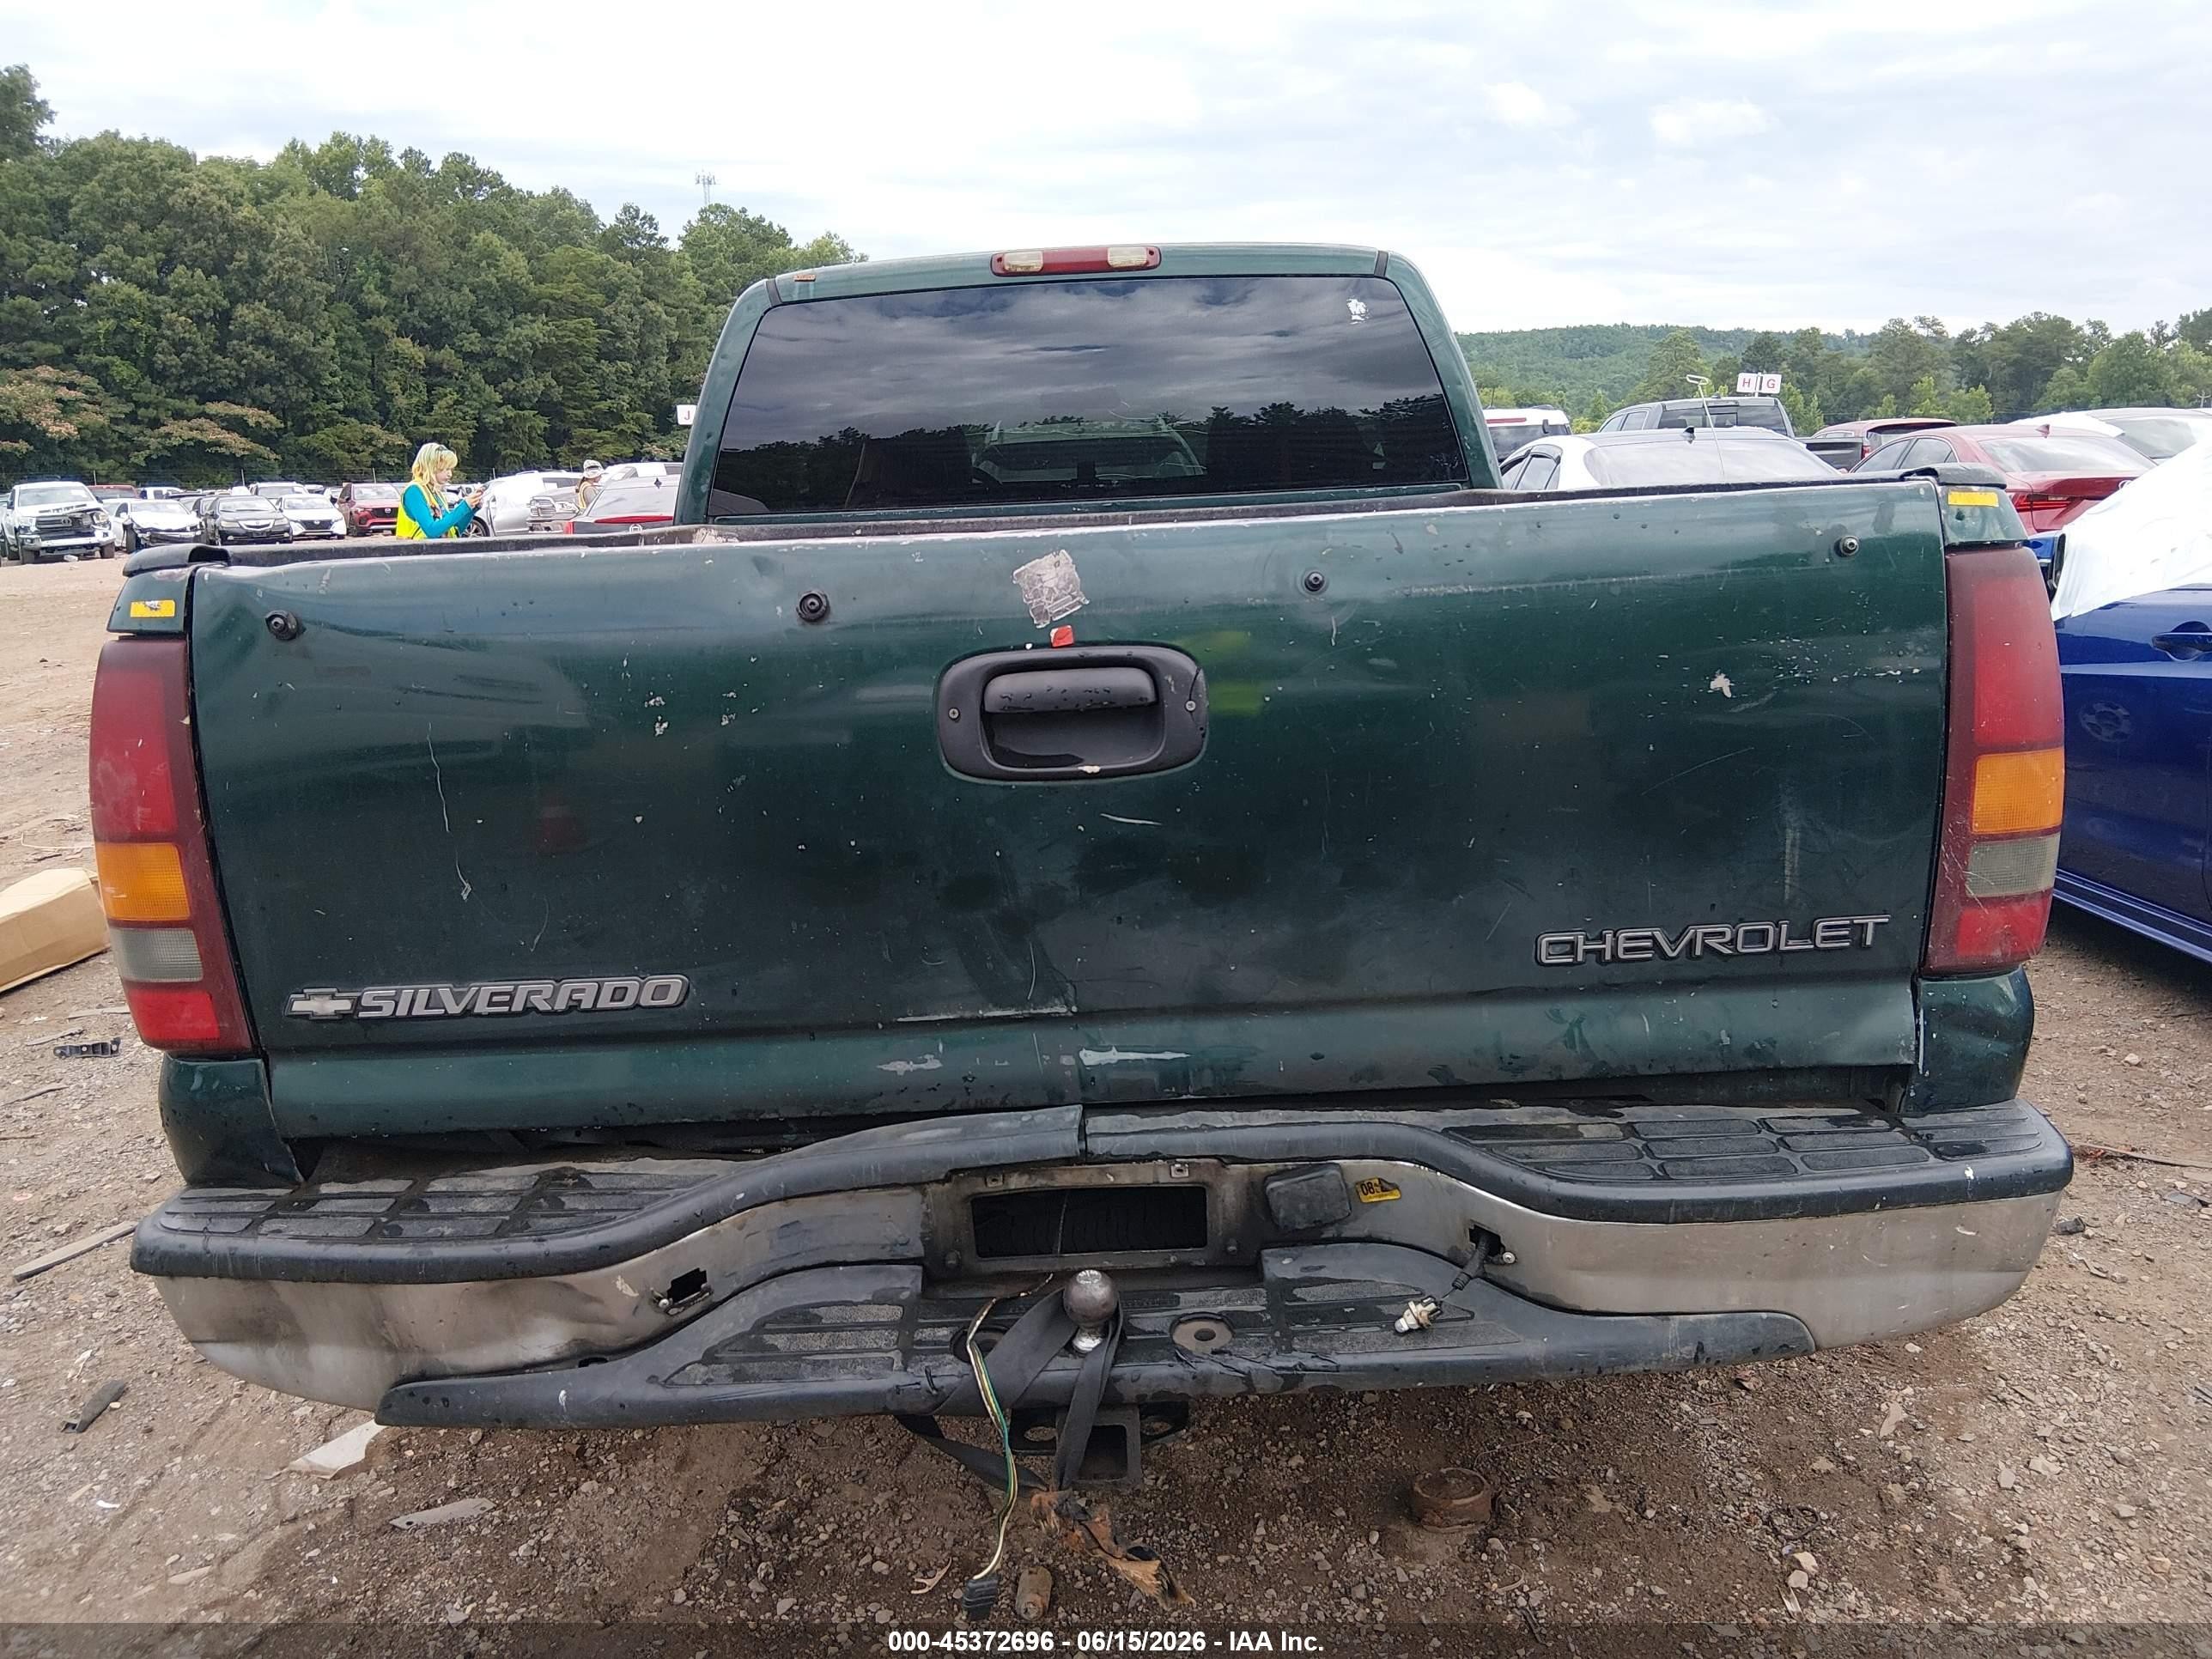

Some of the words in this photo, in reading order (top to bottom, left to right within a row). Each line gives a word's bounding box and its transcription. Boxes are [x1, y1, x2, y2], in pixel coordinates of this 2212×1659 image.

[1742, 378, 1752, 388] H
[1766, 379, 1776, 389] G
[684, 410, 691, 421] J
[1535, 915, 1892, 966] CHEVROLET
[355, 975, 690, 1019] SILVERADO
